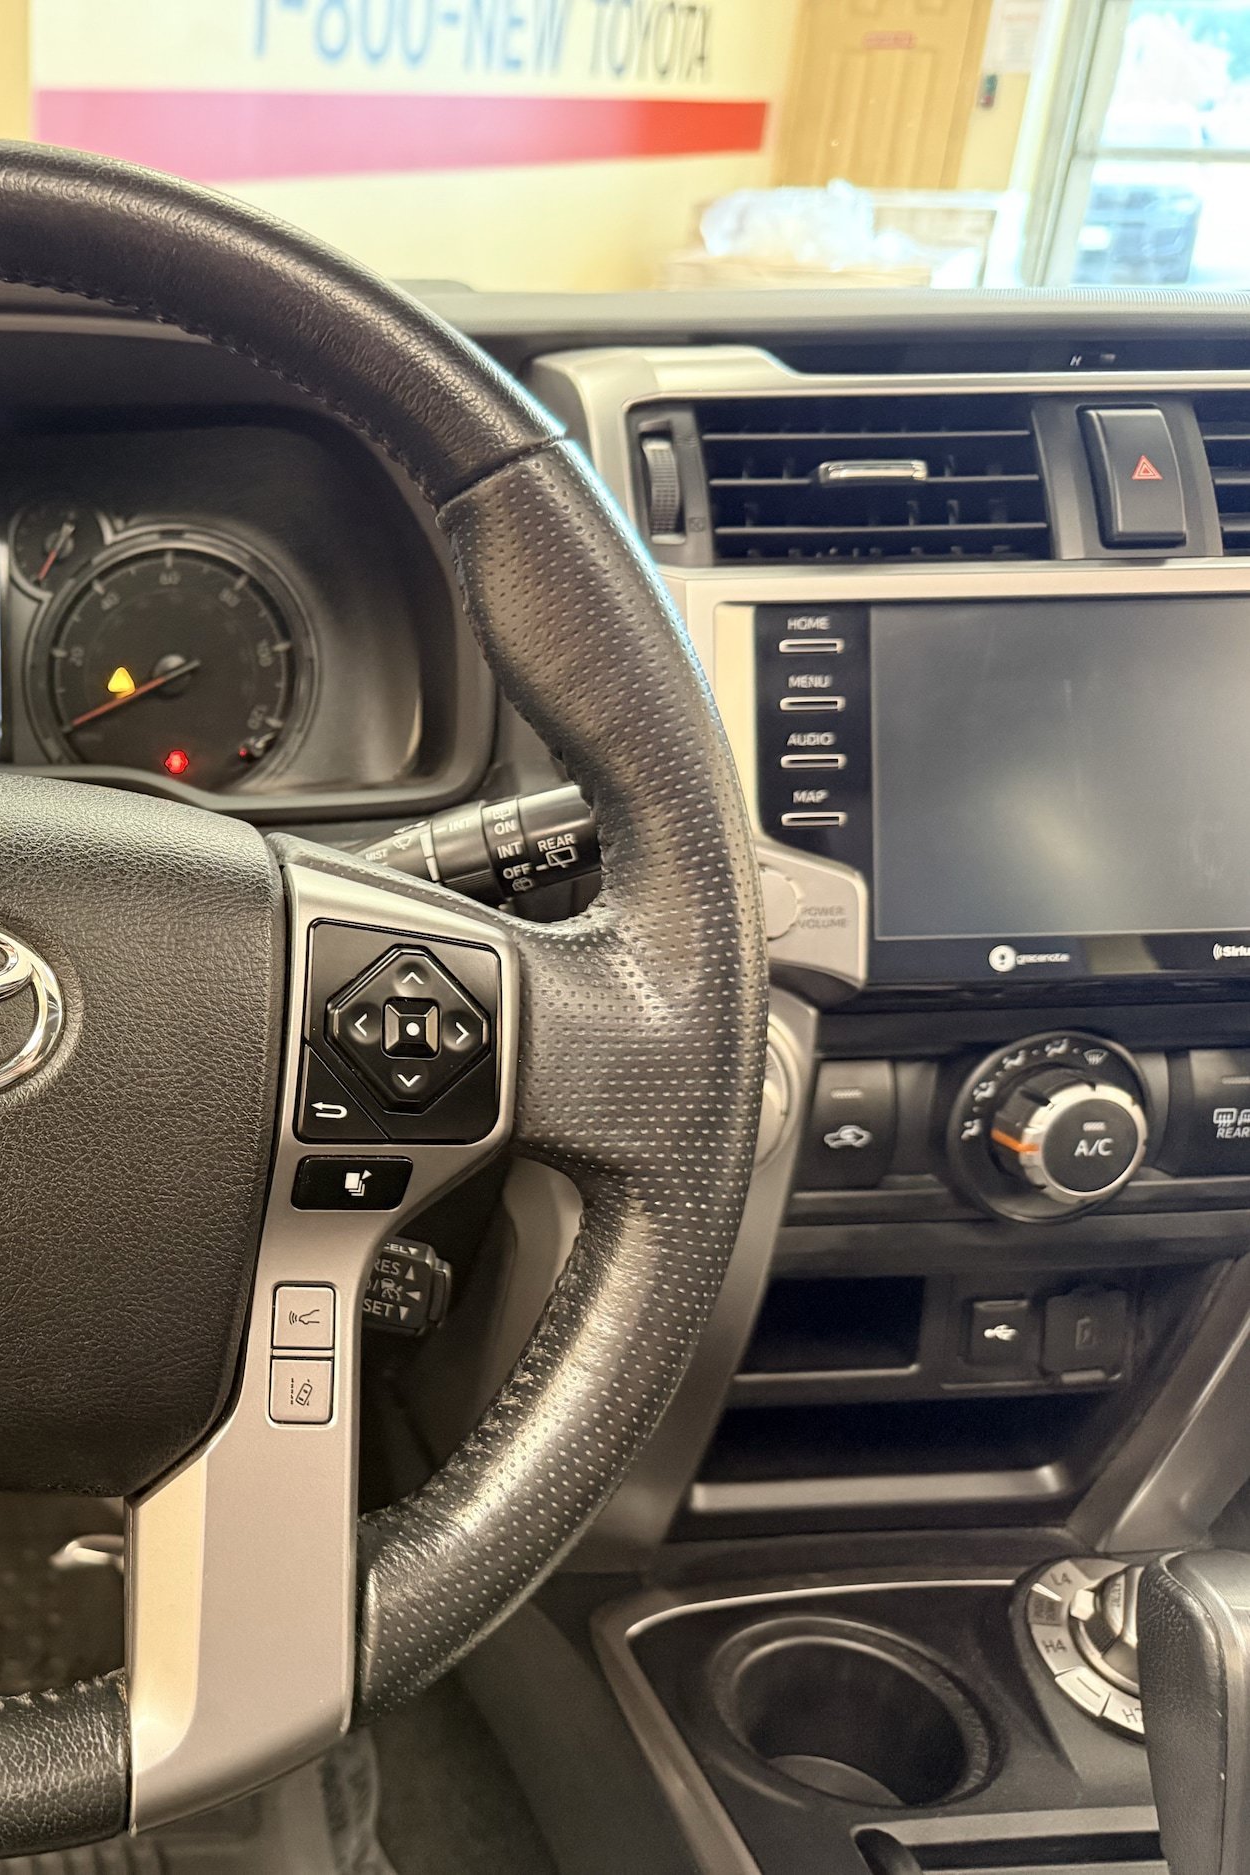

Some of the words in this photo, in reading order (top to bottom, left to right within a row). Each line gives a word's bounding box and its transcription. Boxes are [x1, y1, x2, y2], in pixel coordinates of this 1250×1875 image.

[590, 0, 712, 82] TOYOTA
[787, 616, 831, 630] HOME
[788, 674, 832, 688] MENU
[787, 732, 835, 746] AUDIO
[792, 789, 829, 803] MAP
[448, 818, 472, 832] INT
[494, 819, 516, 835] ON
[537, 833, 576, 852] REAR
[365, 849, 389, 862] MIST
[497, 841, 524, 859] INT
[503, 863, 533, 880] OFF
[1216, 1127, 1250, 1139] REAR
[1075, 1137, 1113, 1157] A/C
[362, 1298, 394, 1317] SET
[1050, 1572, 1073, 1586] L4
[1042, 1639, 1068, 1653] H4
